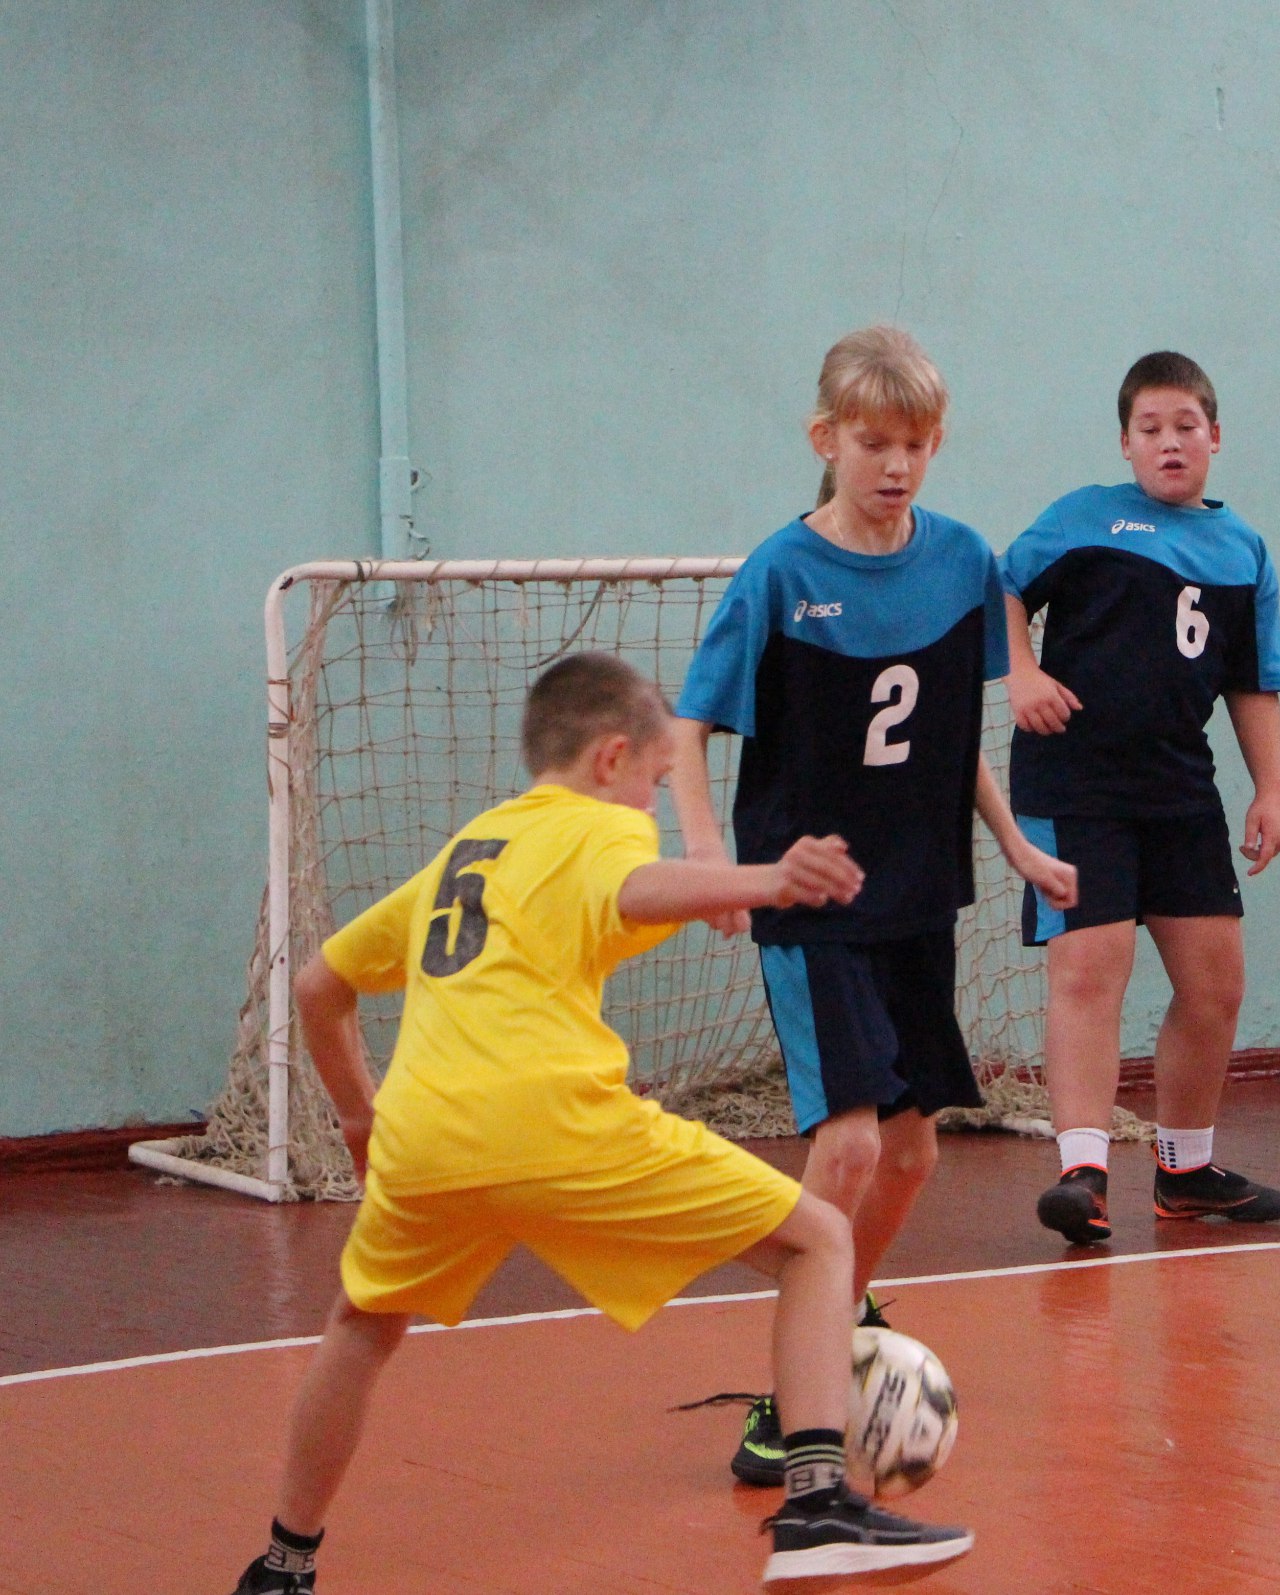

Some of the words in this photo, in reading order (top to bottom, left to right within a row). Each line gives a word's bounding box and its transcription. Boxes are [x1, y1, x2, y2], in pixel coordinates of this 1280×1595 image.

[1125, 521, 1156, 534] asics
[807, 602, 843, 618] asics
[1177, 586, 1210, 659] 6
[863, 664, 919, 766] 2
[420, 838, 509, 978] 5
